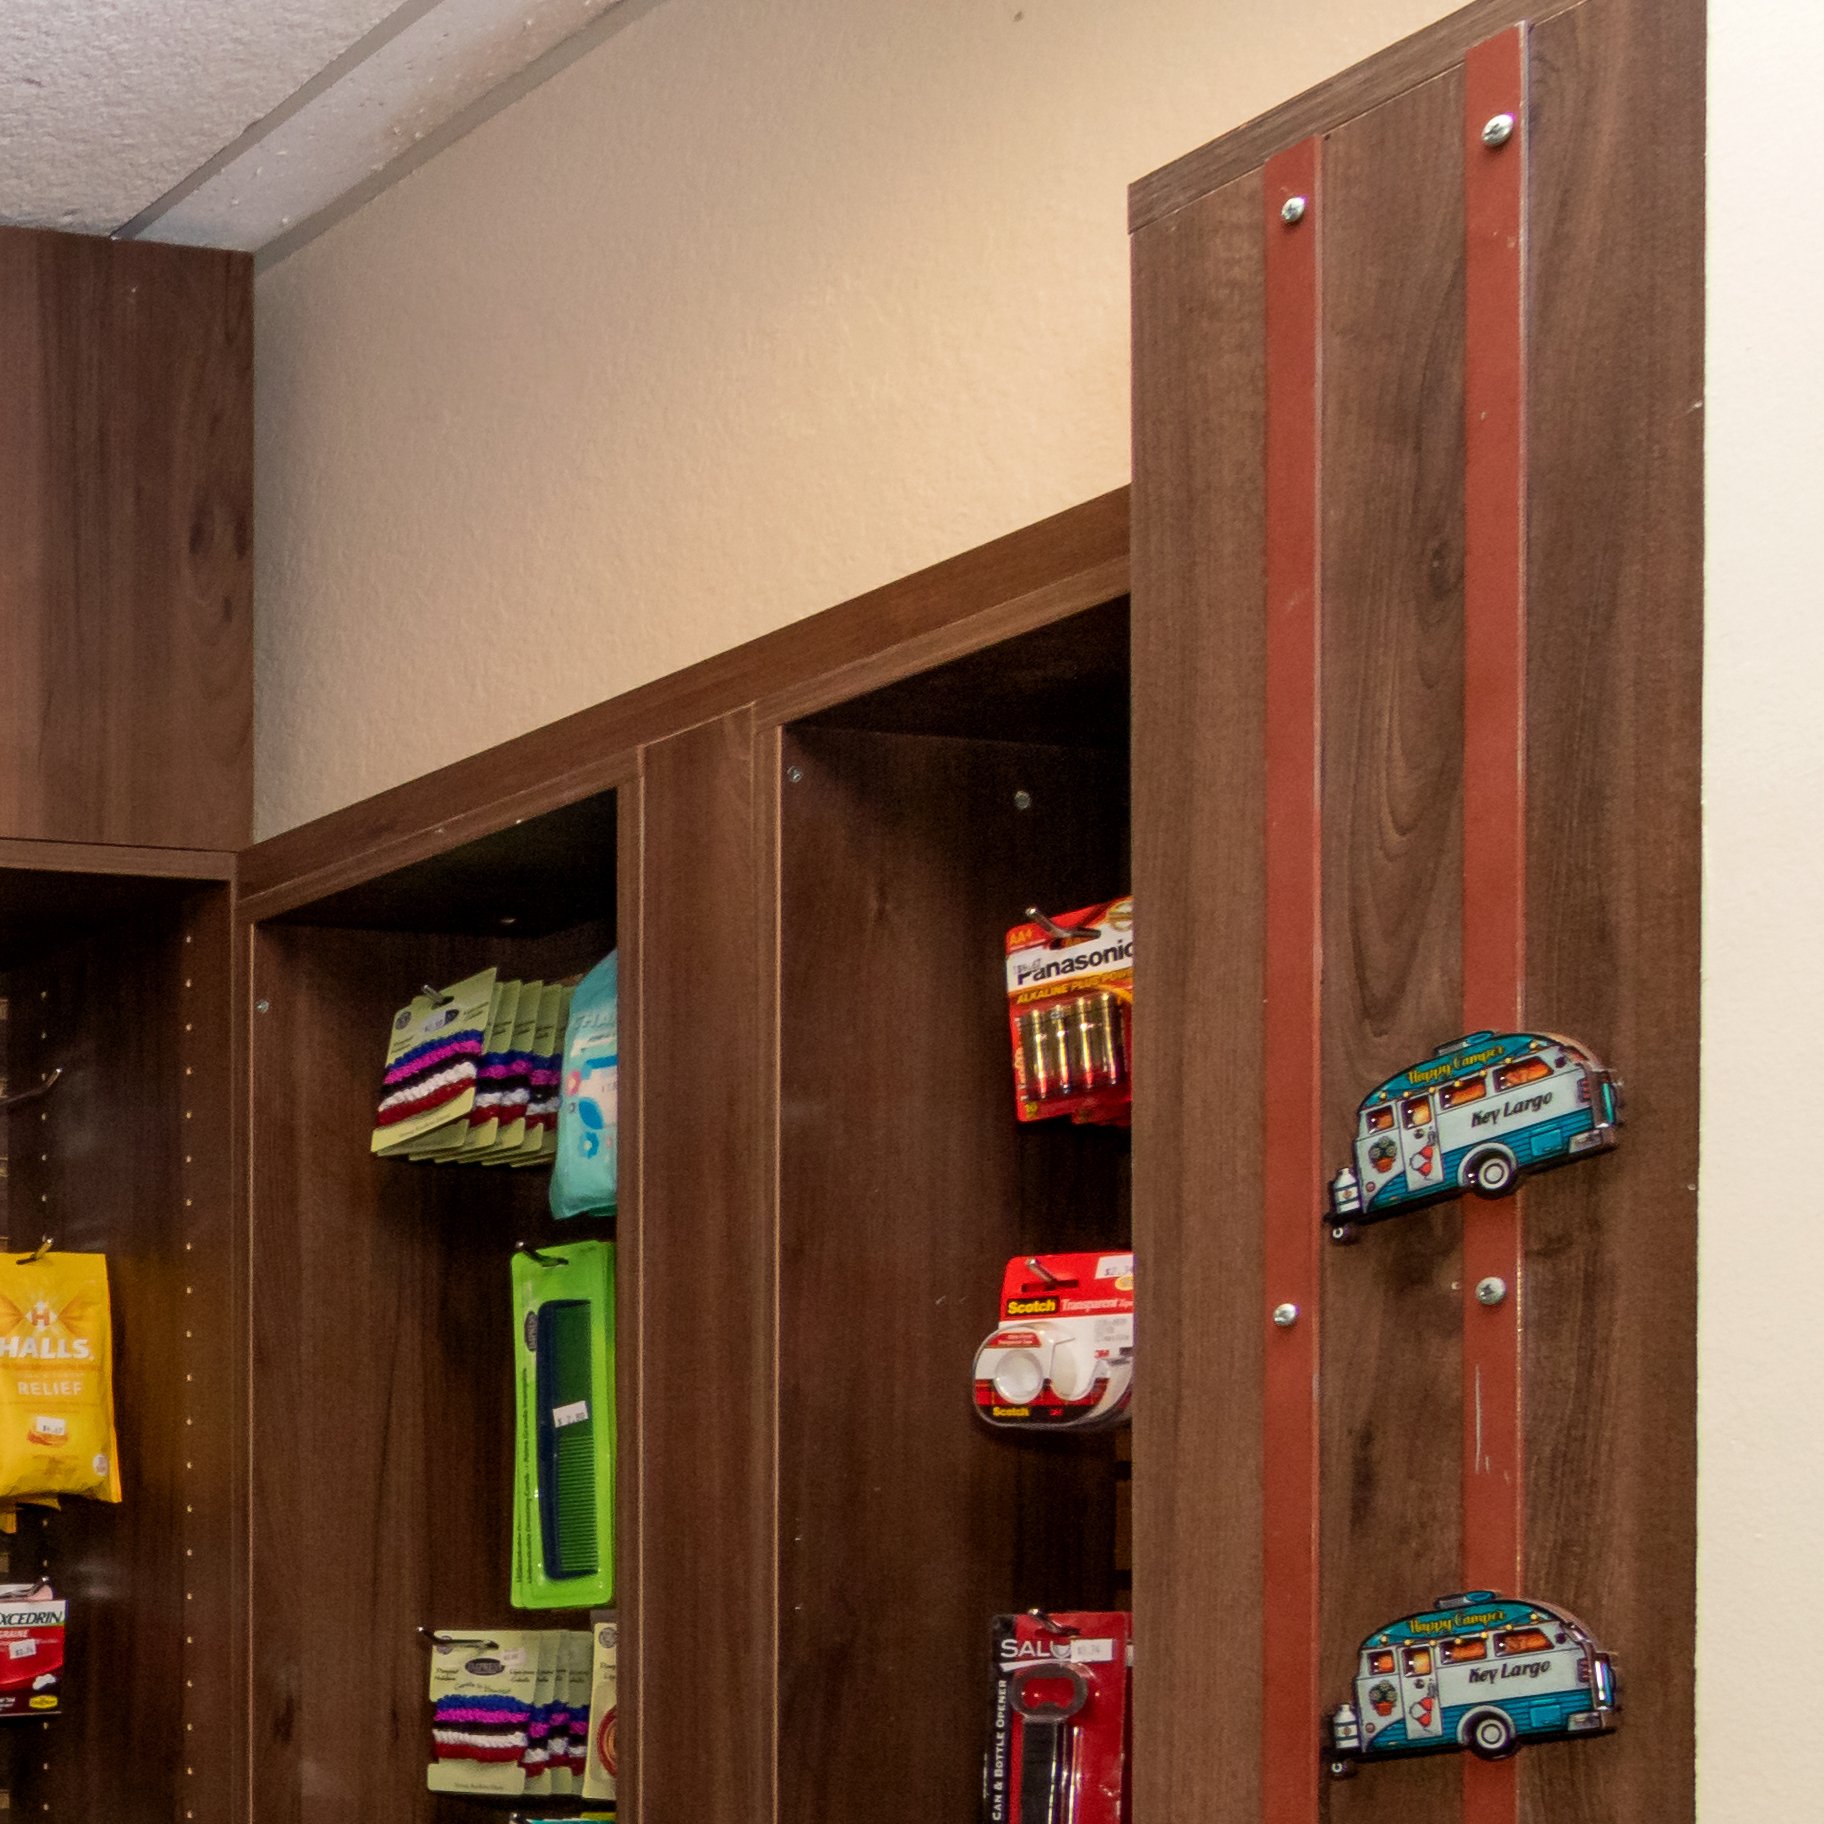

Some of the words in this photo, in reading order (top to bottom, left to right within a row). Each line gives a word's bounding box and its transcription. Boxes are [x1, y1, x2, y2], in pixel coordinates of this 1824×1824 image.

[1016, 983, 1074, 1005] ALKALINE
[1074, 974, 1102, 994] PLUS
[1406, 1062, 1452, 1086] Happy
[1452, 1044, 1505, 1070] Camper
[1470, 1108, 1501, 1130] Key
[1502, 1091, 1554, 1119] Largo
[1007, 1298, 1057, 1315] Scotch
[1061, 1296, 1118, 1312] Transparent
[17, 1380, 82, 1396] RELIEF
[992, 1405, 1030, 1418] Scotch
[1408, 1614, 1452, 1635] Happy
[1453, 1609, 1506, 1628] Camper
[1468, 1666, 1499, 1685] Key
[1500, 1658, 1551, 1680] Largo
[995, 1679, 1007, 1730] OPENER
[994, 1731, 1005, 1777] BOTTLE
[992, 1793, 1002, 1823] CAN
